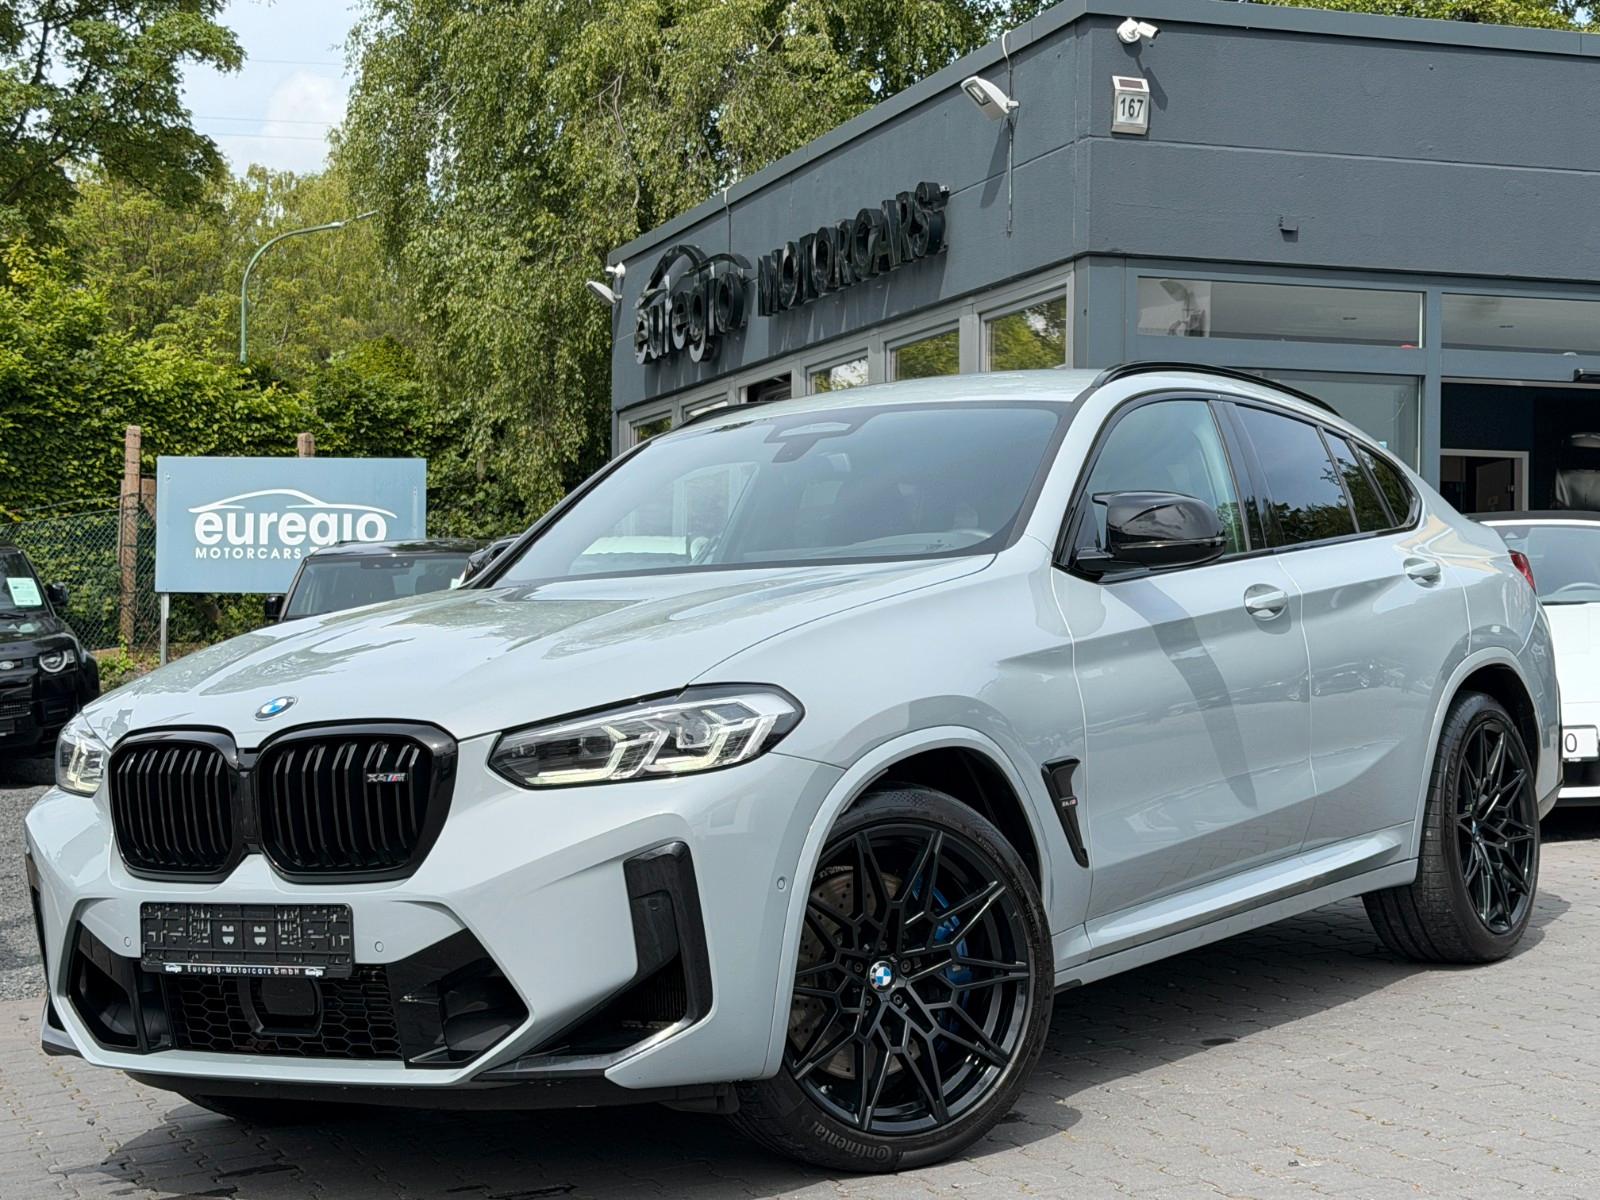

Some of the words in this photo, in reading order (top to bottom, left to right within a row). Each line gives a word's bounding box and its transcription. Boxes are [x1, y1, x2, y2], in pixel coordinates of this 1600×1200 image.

[1120, 97, 1144, 118] 167
[757, 181, 948, 317] MOTORCARS
[194, 512, 387, 546] euregio
[195, 547, 302, 560] MOTORCARS
